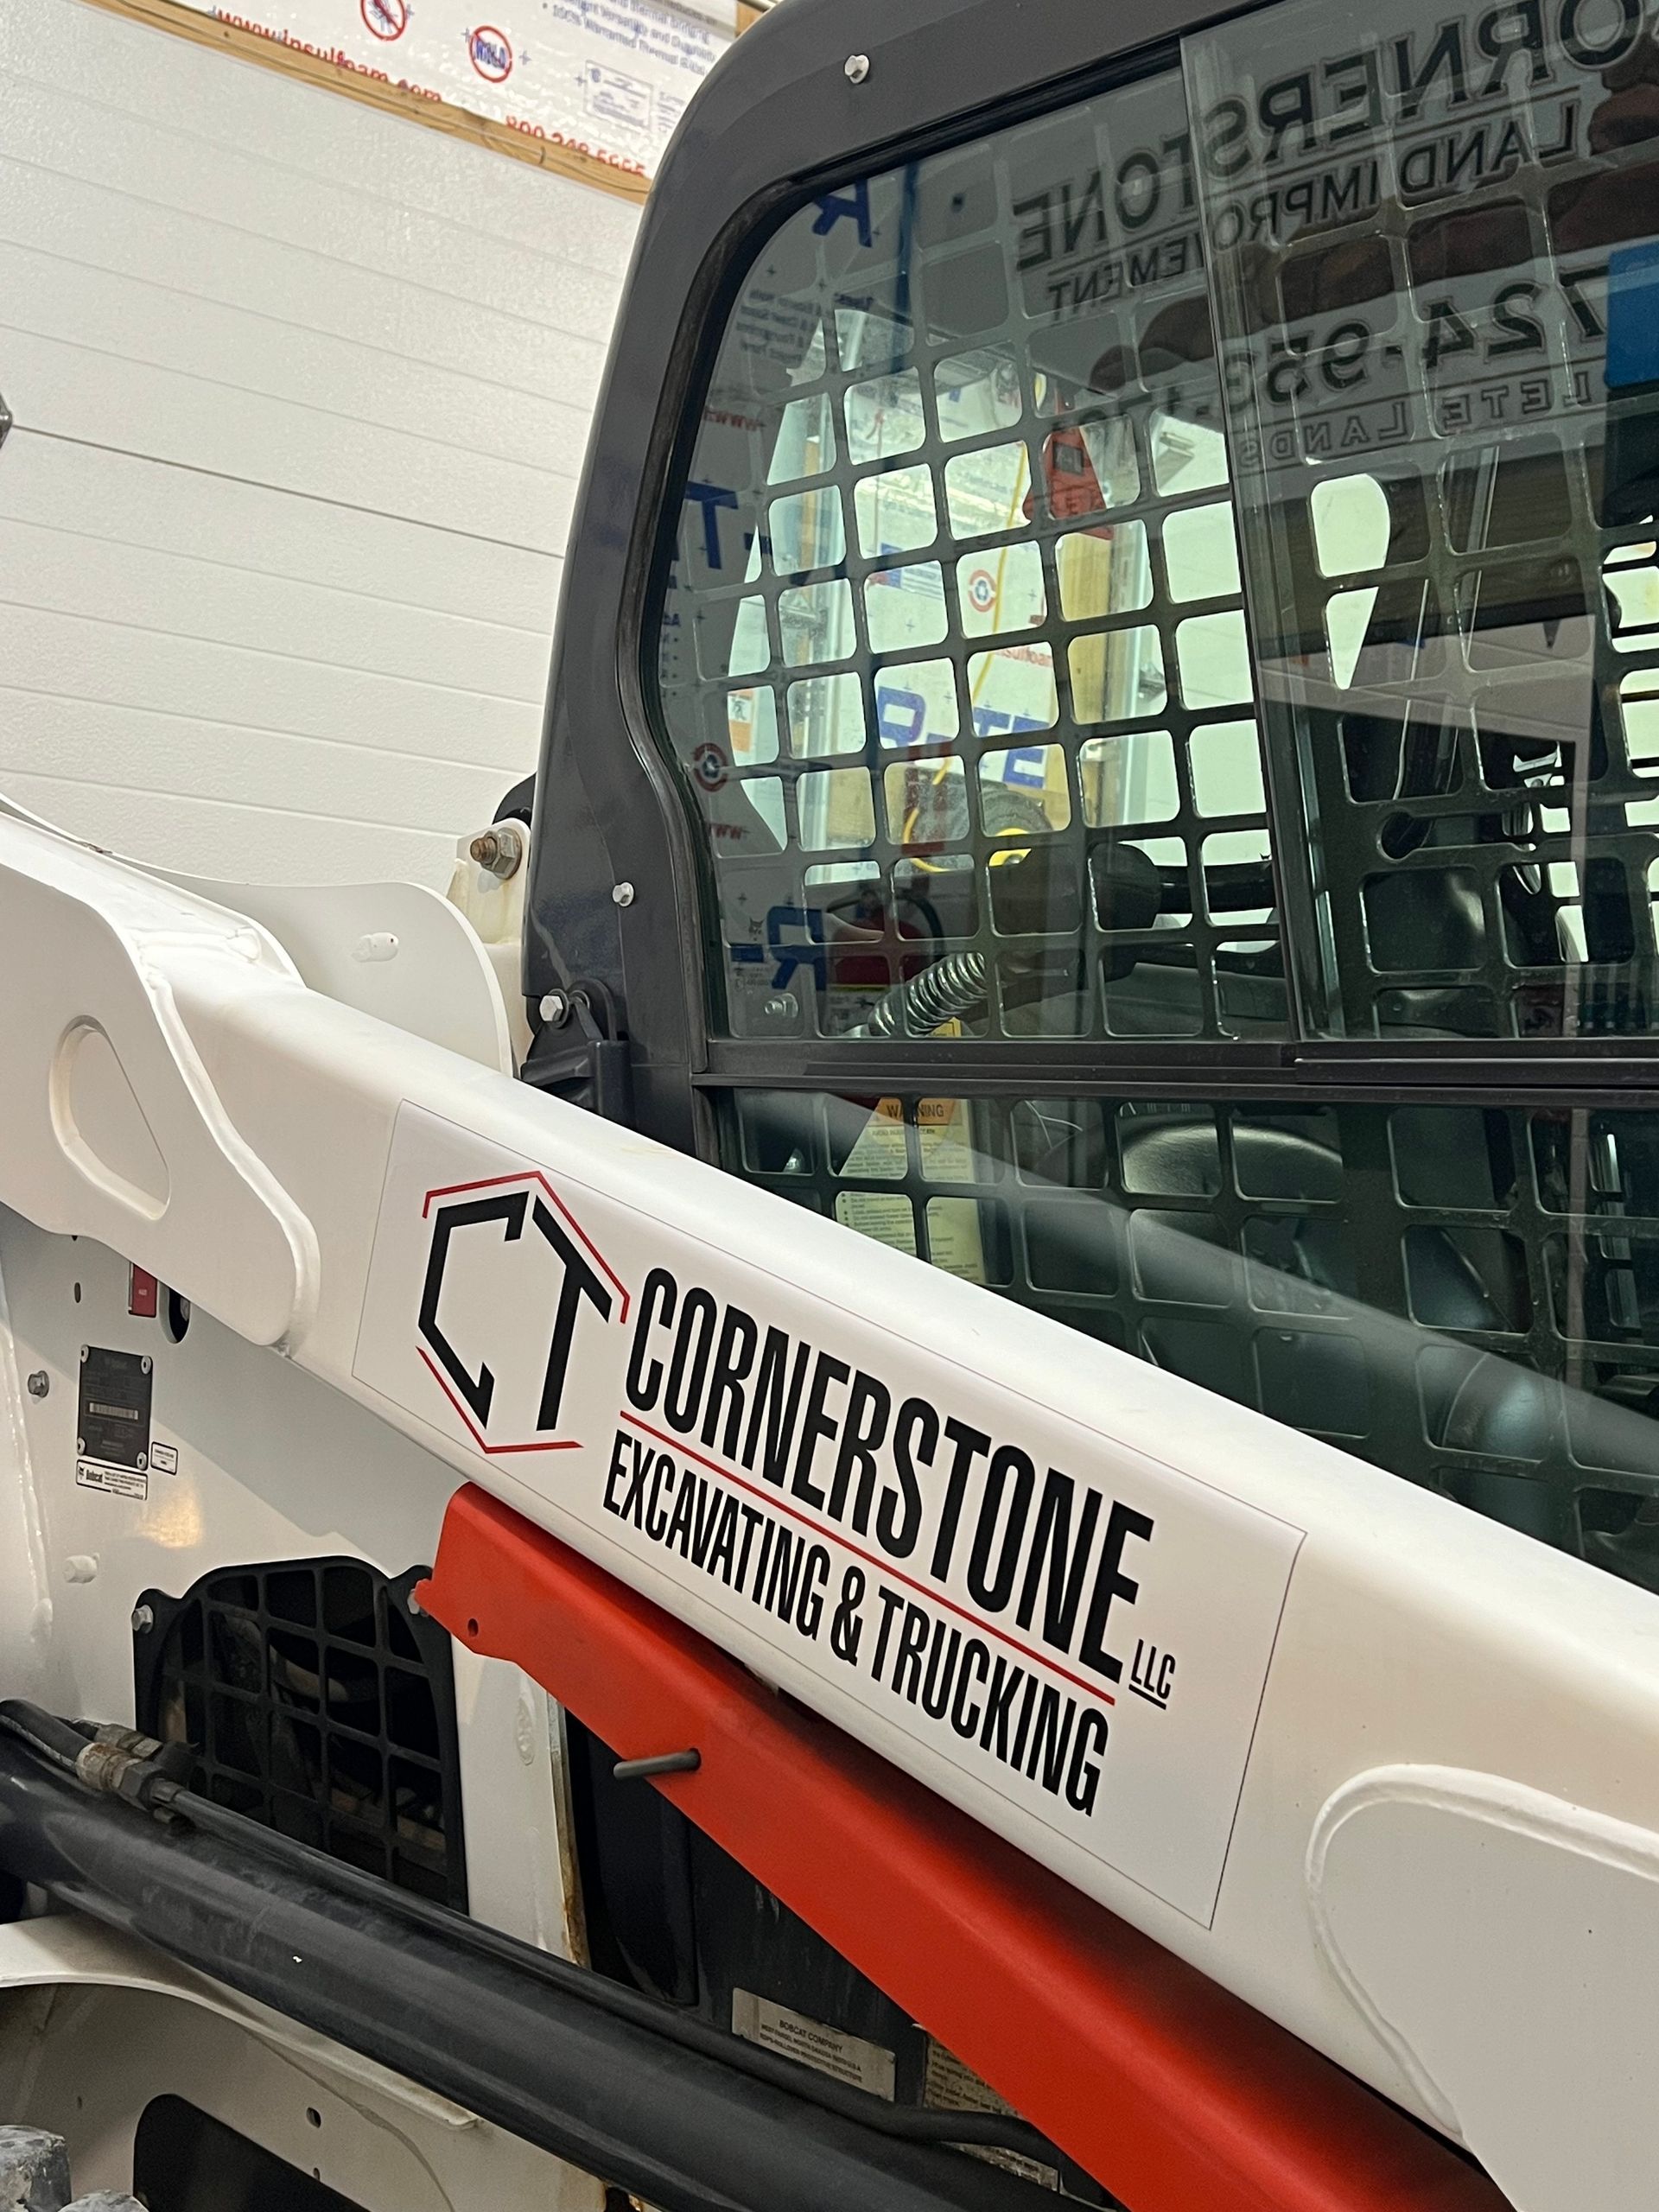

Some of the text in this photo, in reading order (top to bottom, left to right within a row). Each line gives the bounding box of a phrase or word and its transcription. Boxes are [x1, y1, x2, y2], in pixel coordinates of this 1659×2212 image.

[886, 1104, 944, 1117] WNING
[625, 1267, 1176, 1700] CORNERSTONE LLC
[602, 1430, 1110, 1816] EXCAVATING & TRUCKING
[779, 2019, 843, 2054] BOBCAT COMPANY
